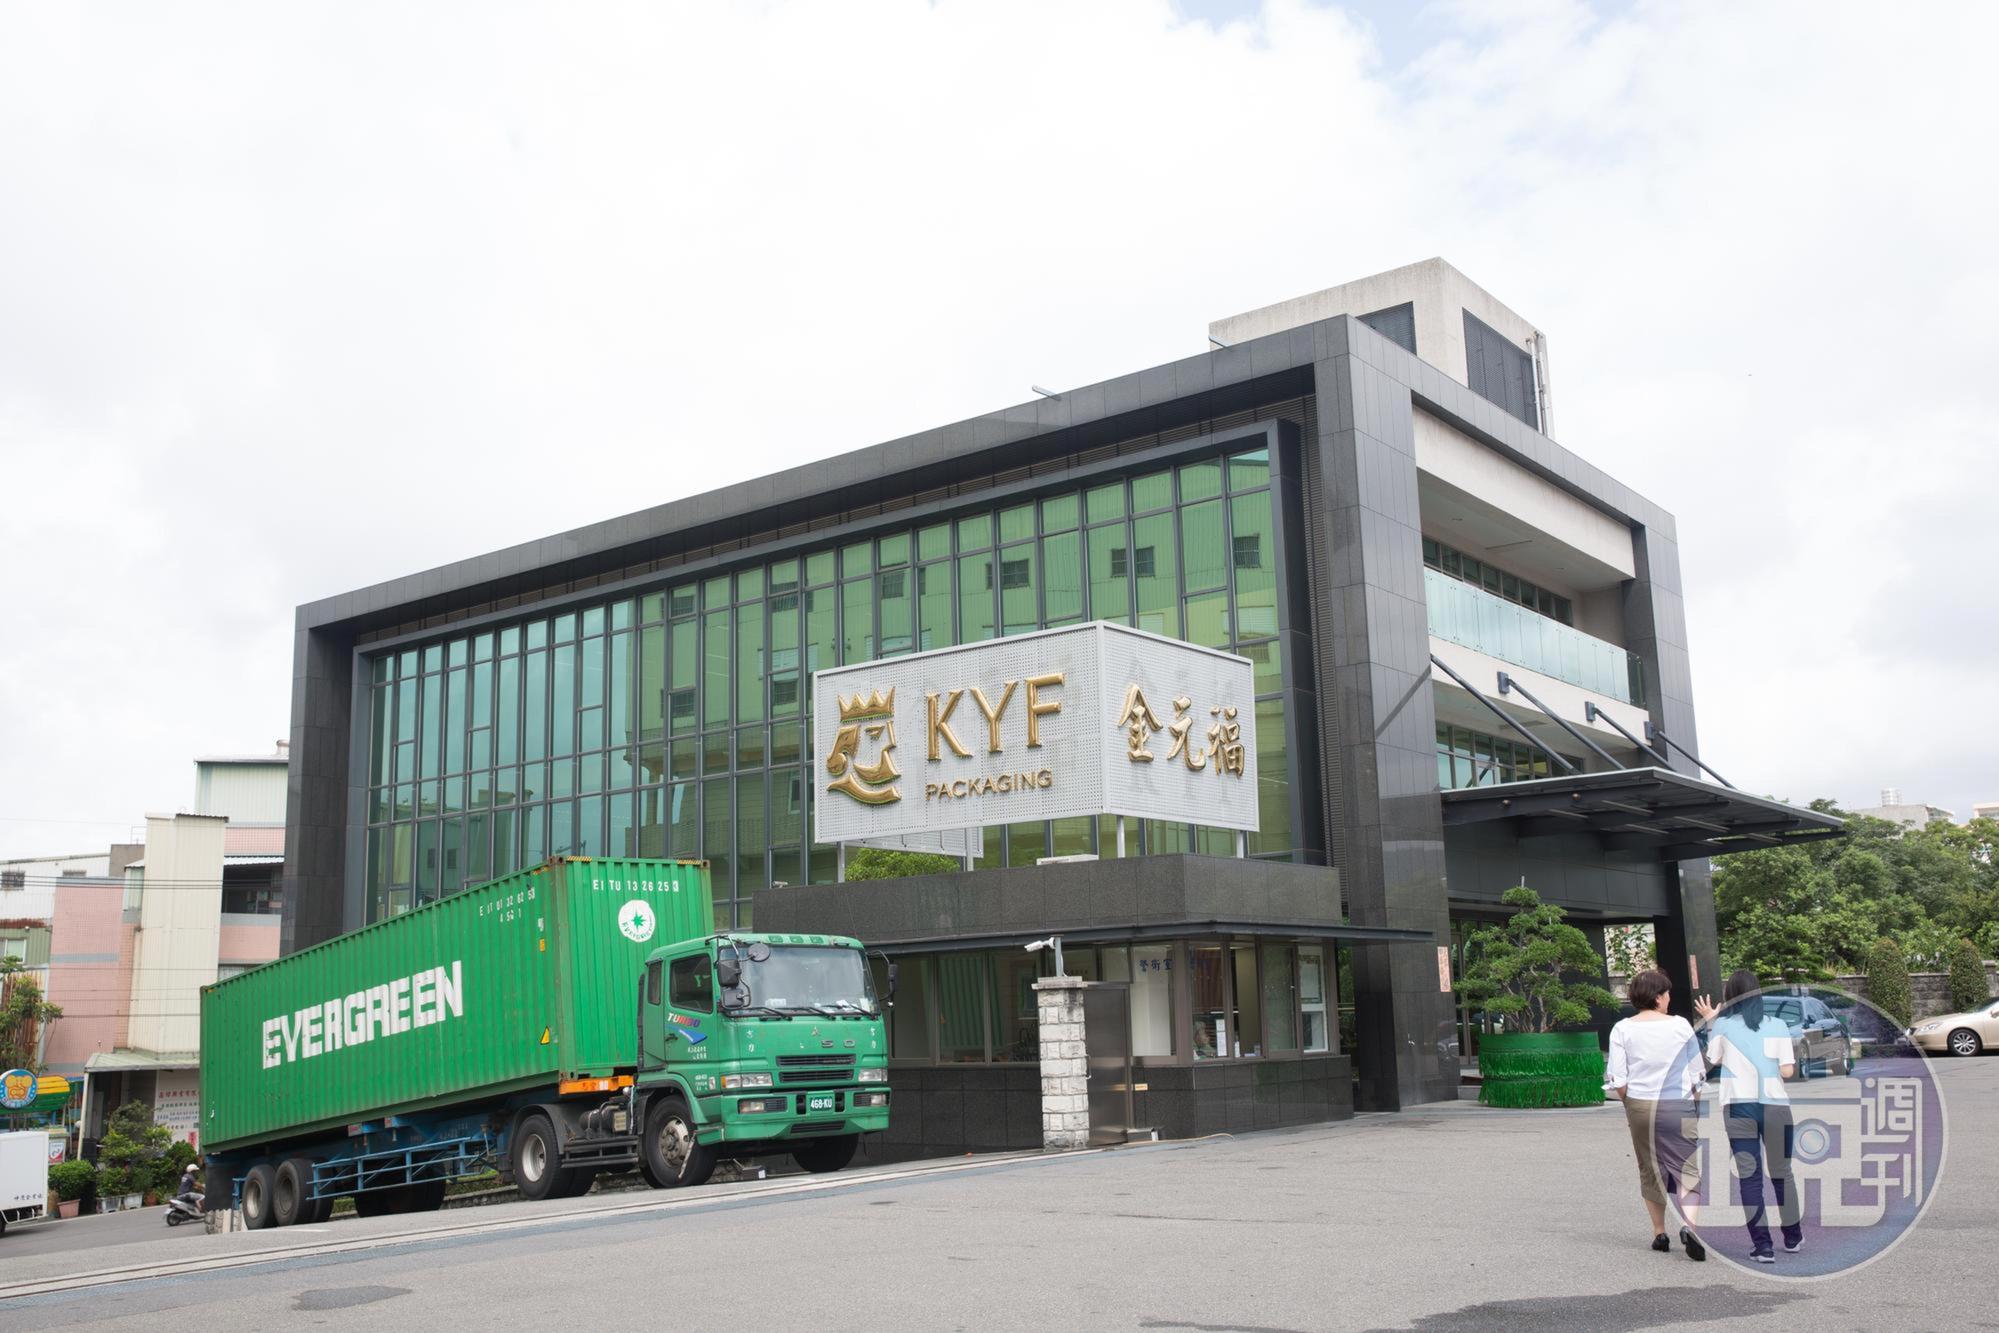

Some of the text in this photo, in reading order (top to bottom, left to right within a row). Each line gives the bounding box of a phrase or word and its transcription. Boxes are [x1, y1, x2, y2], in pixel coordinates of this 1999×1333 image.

[926, 672, 1066, 761] KYF
[1118, 683, 1246, 778] 金元福
[925, 769, 1053, 801] PACKAGING
[263, 960, 463, 1069] EVERGREEN
[667, 1012, 701, 1028] TURBO
